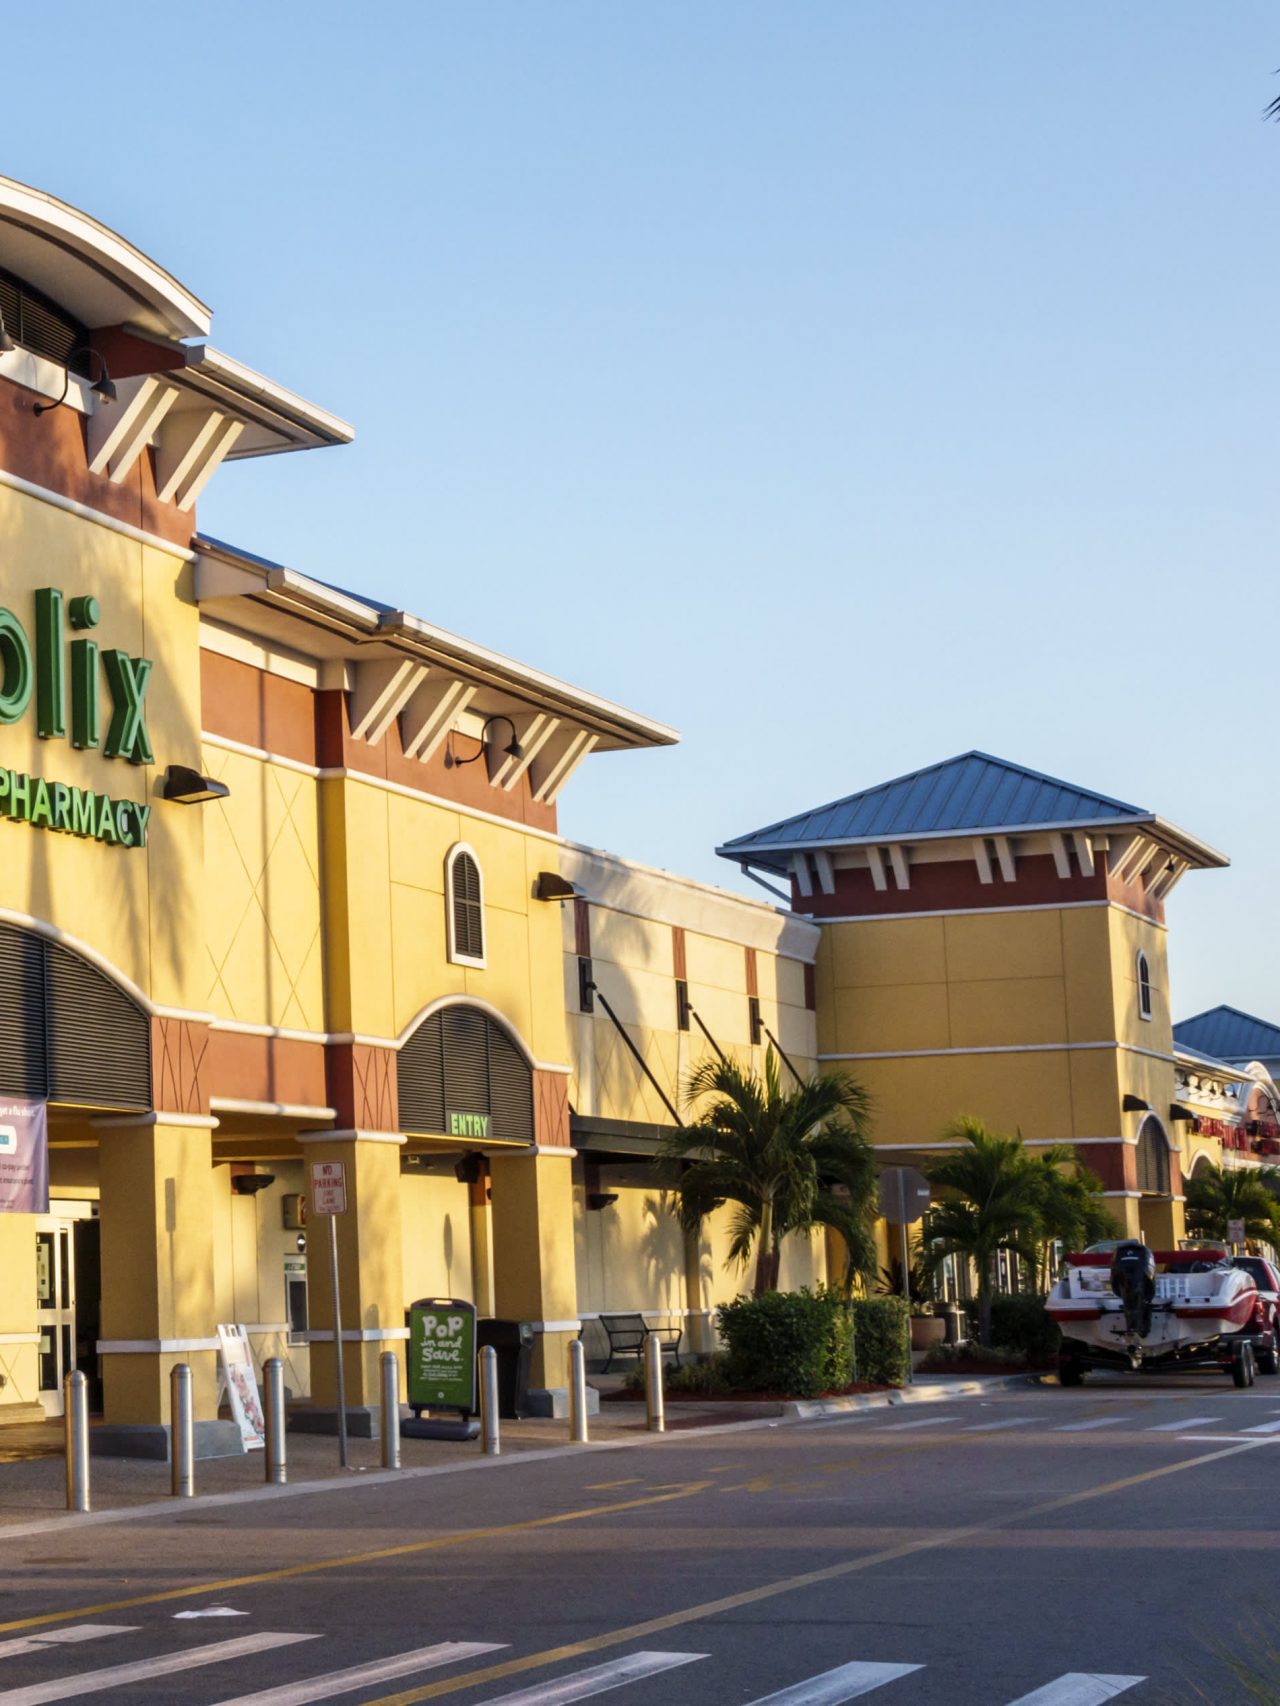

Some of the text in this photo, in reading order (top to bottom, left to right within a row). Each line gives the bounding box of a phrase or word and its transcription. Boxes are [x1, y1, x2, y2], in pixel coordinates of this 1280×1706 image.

[451, 1113, 488, 1137] ENTRY
[420, 1336, 463, 1348] in and
